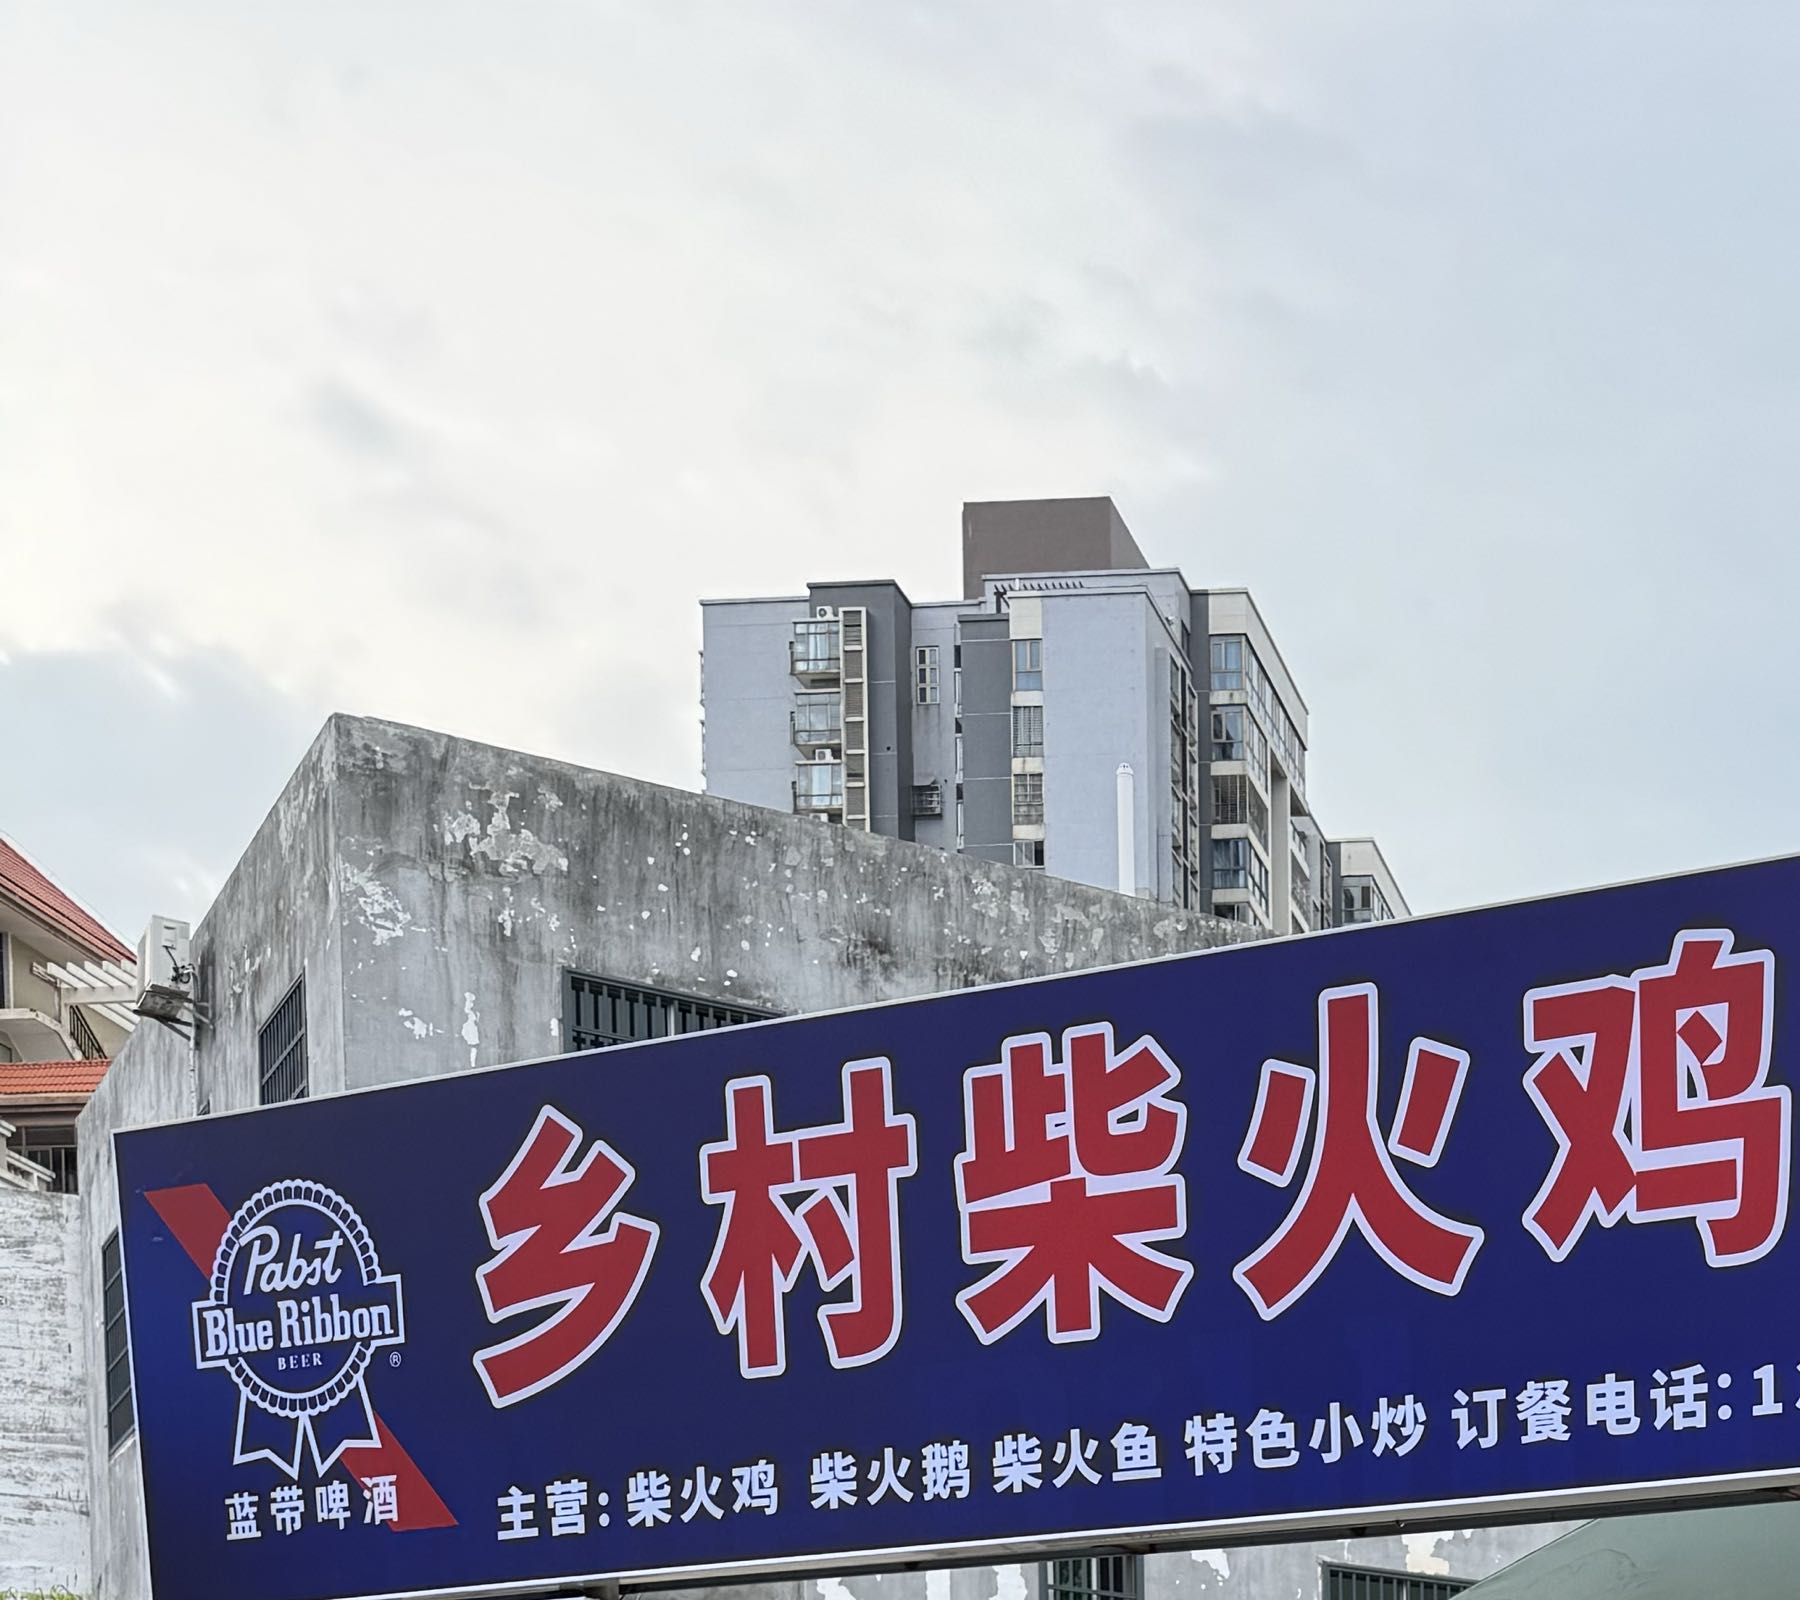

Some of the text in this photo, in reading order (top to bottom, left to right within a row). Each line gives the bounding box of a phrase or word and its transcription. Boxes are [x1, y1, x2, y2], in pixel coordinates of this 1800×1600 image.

[238, 1224, 344, 1296] Pabst
[202, 1293, 395, 1358] Blue Ribbon
[277, 1352, 323, 1371] BEER
[810, 1439, 971, 1510] 柴火鹅
[992, 1422, 1162, 1494] 柴火鱼
[1184, 1394, 1427, 1477] 特色小炒
[224, 1474, 399, 1541] 蓝带啤酒
